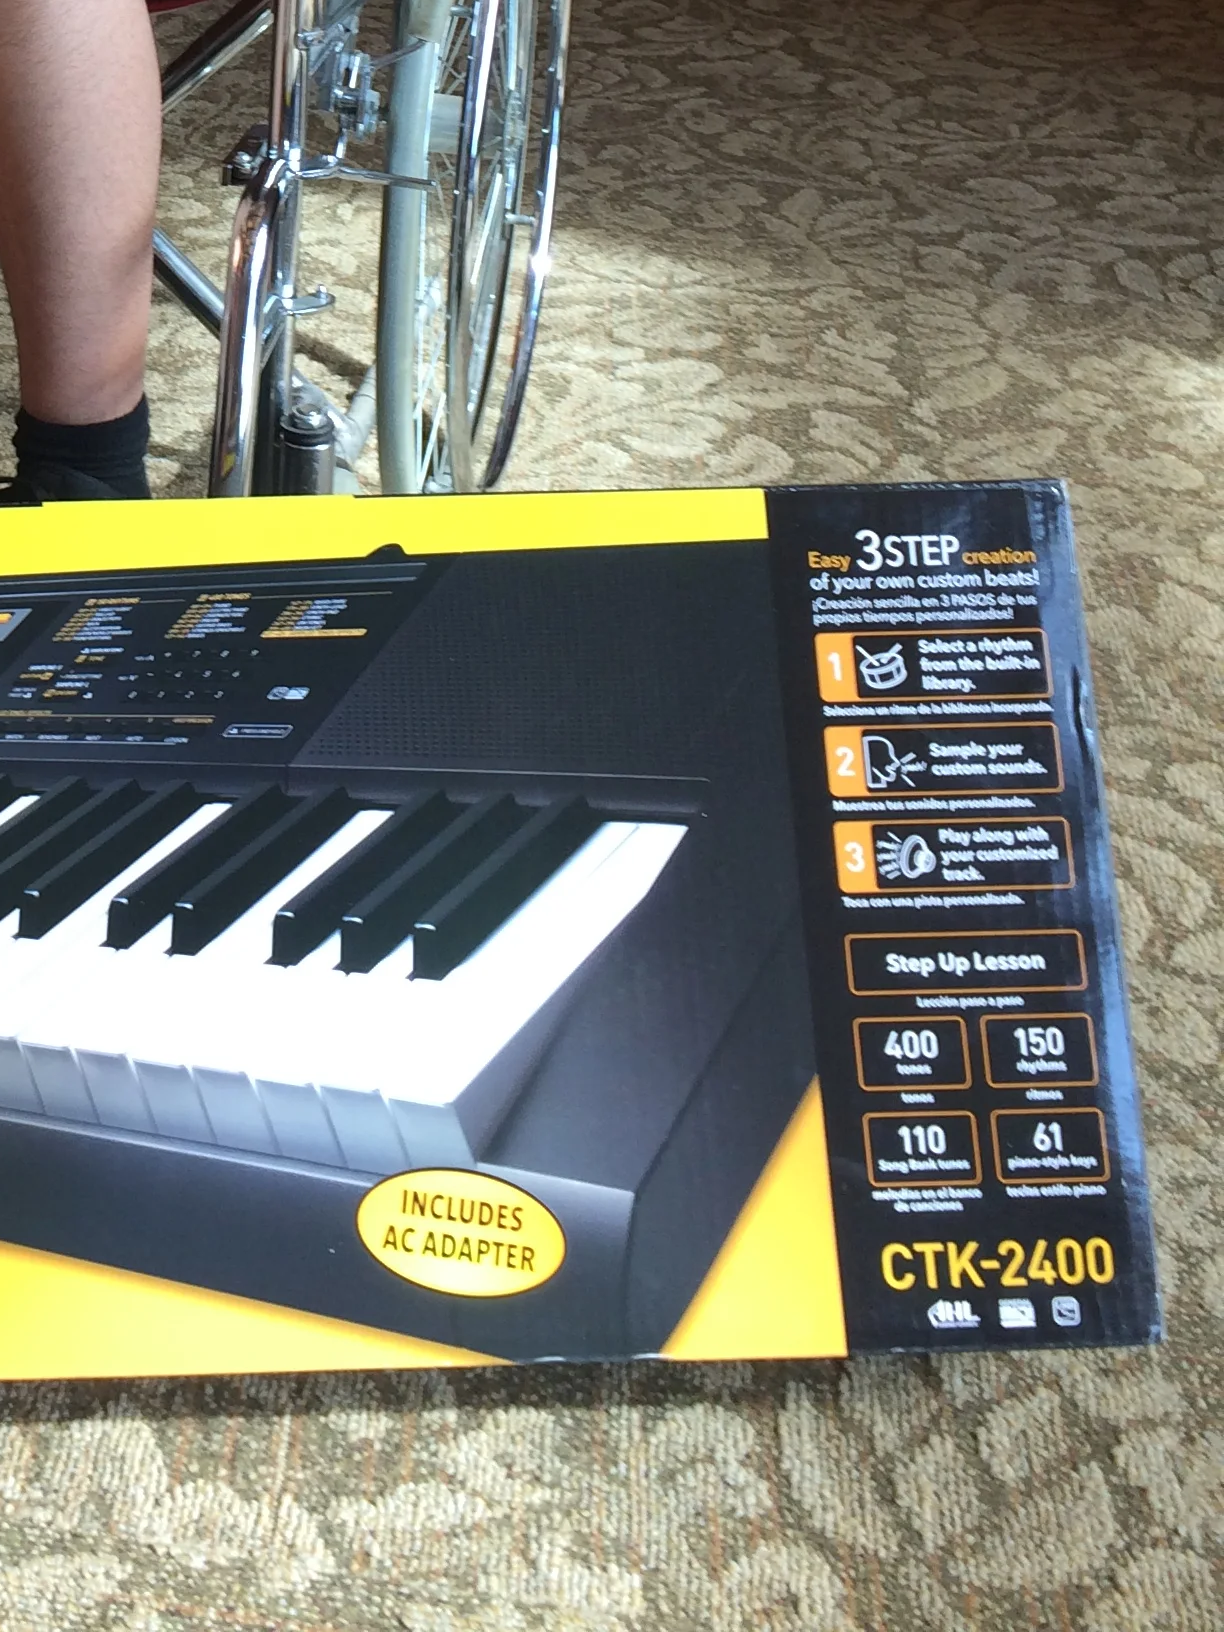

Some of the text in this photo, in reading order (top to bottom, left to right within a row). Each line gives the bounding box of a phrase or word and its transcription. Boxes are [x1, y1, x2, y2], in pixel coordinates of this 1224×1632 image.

[807, 551, 851, 572] Easy
[962, 547, 1037, 565] creation
[809, 568, 1040, 595] of your own custom beats!
[917, 637, 965, 654] Select
[978, 636, 1033, 655] rhythm
[827, 652, 843, 681] 1
[919, 656, 957, 672] from
[958, 656, 984, 671] the
[835, 746, 855, 777] 2
[928, 741, 1024, 761] Sample your
[931, 761, 987, 776] custom
[938, 826, 1050, 846] Play along with
[844, 841, 865, 873] 3
[940, 844, 1059, 866] your customized
[885, 951, 1047, 978] Step Up Lesson
[884, 1029, 939, 1060] 400
[1013, 1026, 1065, 1057] 150
[897, 1124, 947, 1155] 110
[1033, 1122, 1063, 1153] 61
[402, 1189, 523, 1232] INCLUDES
[383, 1225, 535, 1272] AC ADAPTER
[881, 1236, 1115, 1291] CTK-2400
